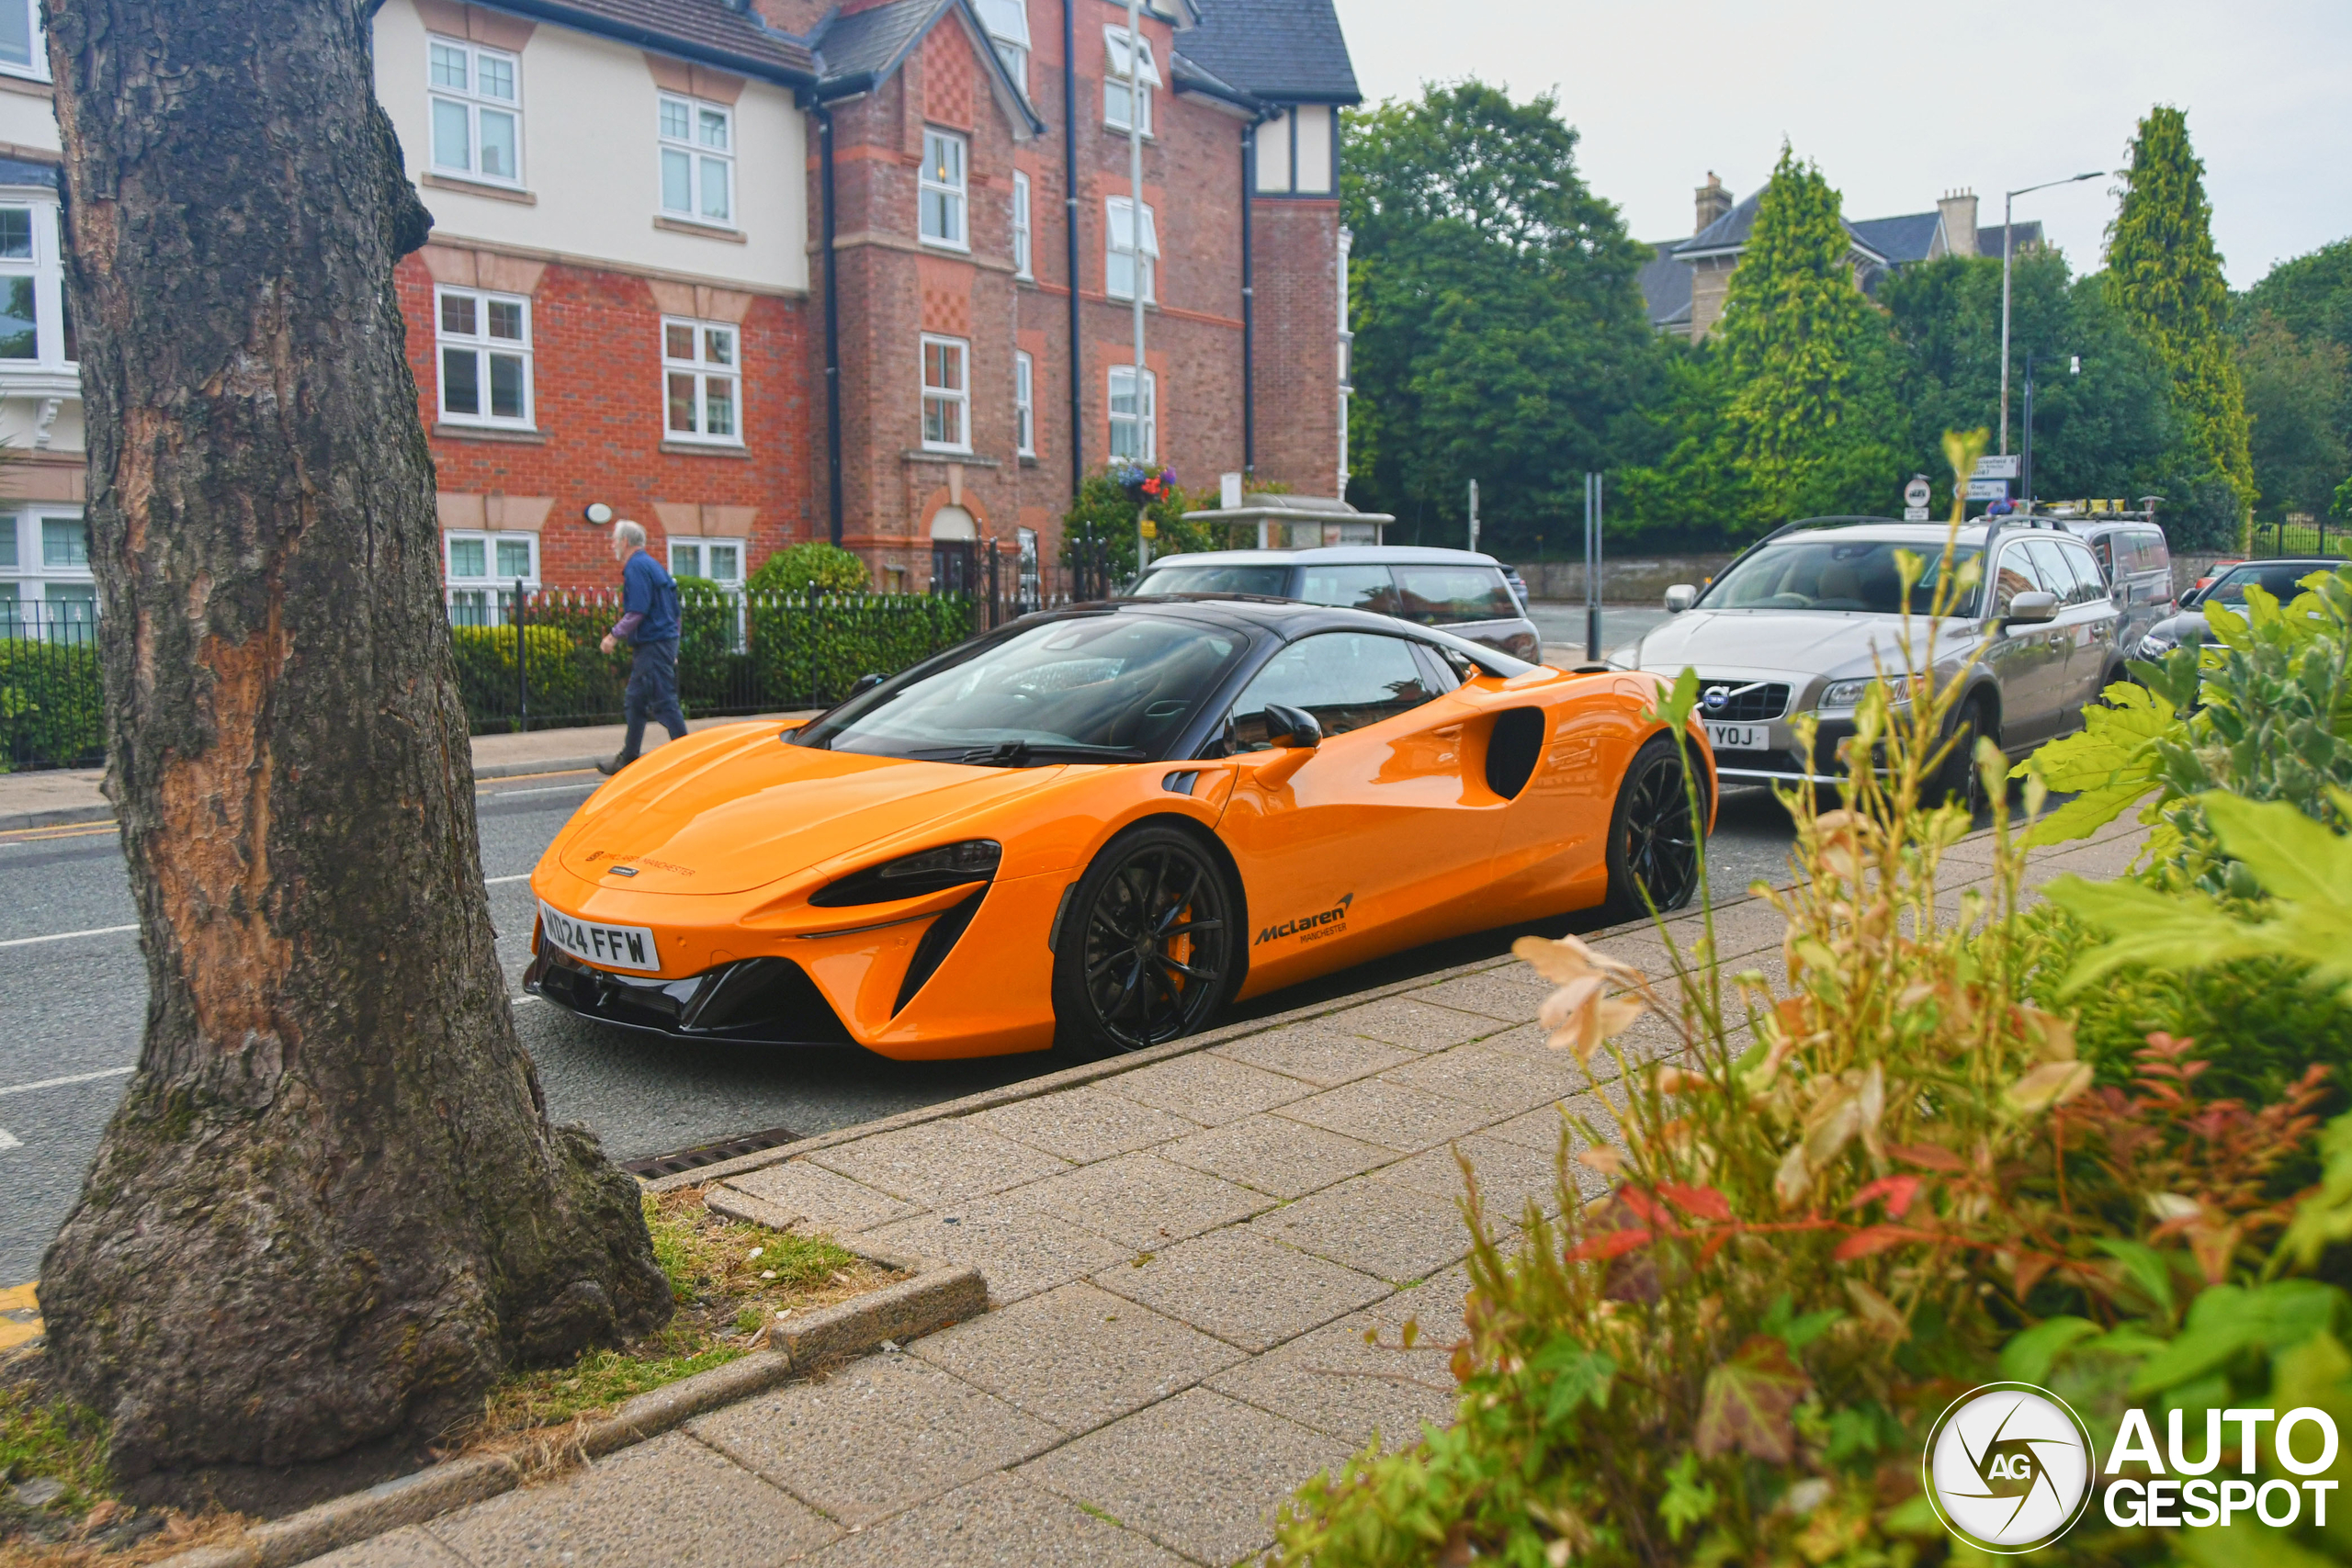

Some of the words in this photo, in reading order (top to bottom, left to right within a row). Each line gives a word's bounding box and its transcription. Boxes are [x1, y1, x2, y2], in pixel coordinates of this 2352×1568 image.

[1715, 727, 1753, 745] YOJ
[1254, 907, 1344, 946] McLaren
[1300, 922, 1347, 944] MANCHESTER
[591, 928, 645, 964] FFW
